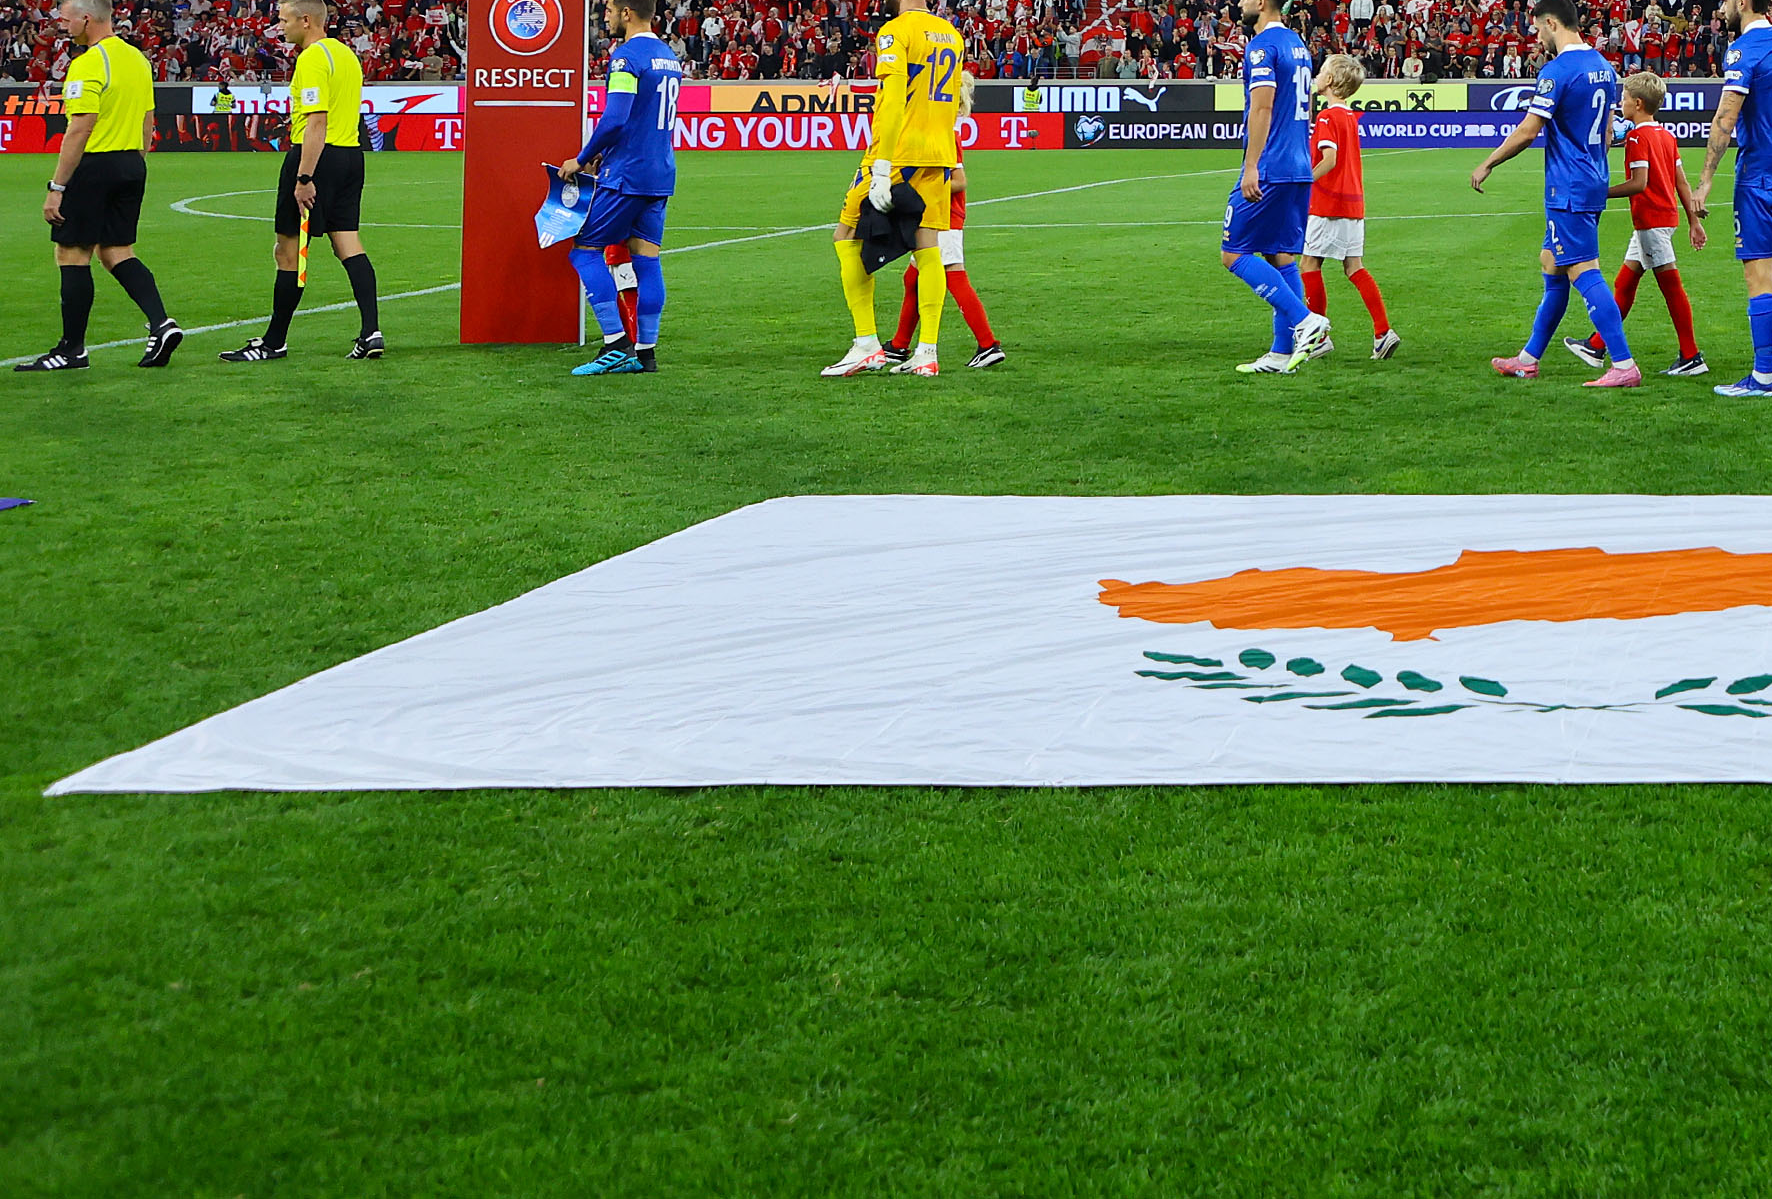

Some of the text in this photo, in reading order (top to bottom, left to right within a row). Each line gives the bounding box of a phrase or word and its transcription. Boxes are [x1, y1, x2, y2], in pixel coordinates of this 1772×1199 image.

[475, 68, 575, 88] RESPECT
[927, 47, 957, 102] 12
[1292, 65, 1311, 120] 19
[656, 75, 680, 131] 18
[1588, 88, 1606, 145] 2
[733, 115, 834, 148] YOUR
[1109, 123, 1207, 140] EUROPEAN
[1368, 124, 1427, 137] WORLD
[1429, 124, 1463, 137] CUP
